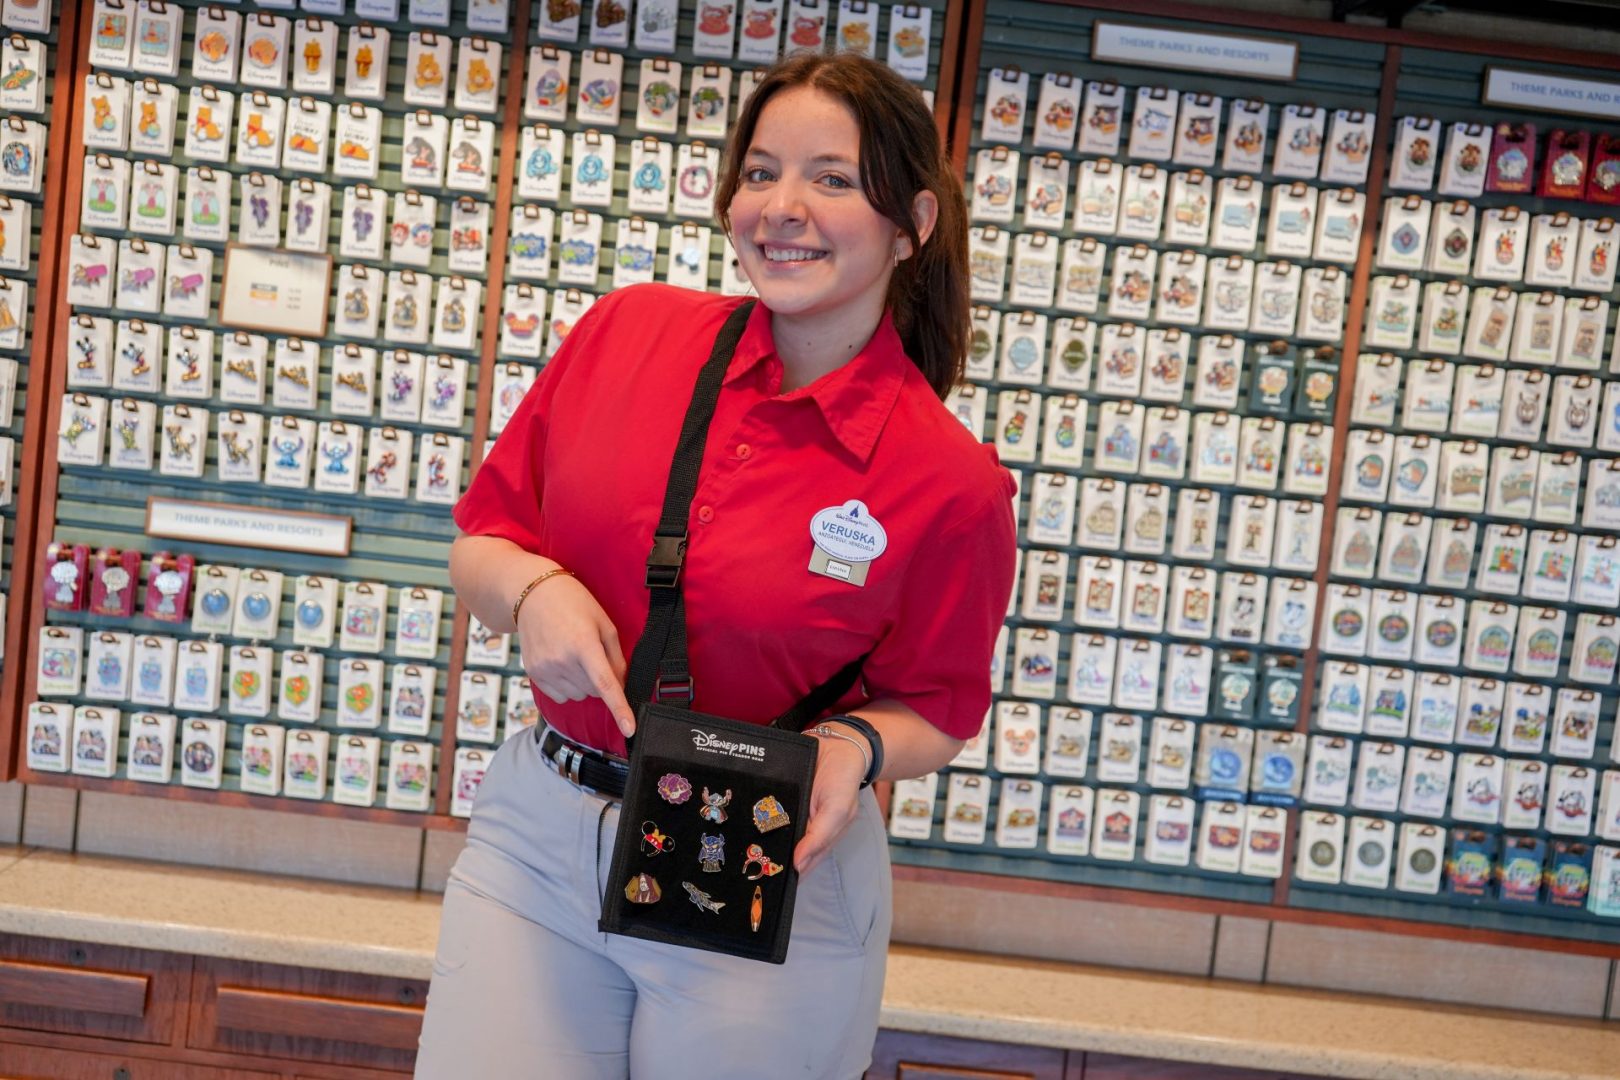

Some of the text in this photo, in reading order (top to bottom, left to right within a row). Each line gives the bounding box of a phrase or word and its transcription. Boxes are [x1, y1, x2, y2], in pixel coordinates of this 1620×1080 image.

[1119, 36, 1270, 62] THEME PARKS AND RESORTS
[1511, 81, 1547, 95] THEME
[1549, 85, 1584, 100] PARKS
[1586, 91, 1611, 103] AND
[175, 512, 324, 538] THEME PARKS AND RESORTS
[822, 520, 875, 545] VERUSKA
[739, 743, 766, 757] PINS
